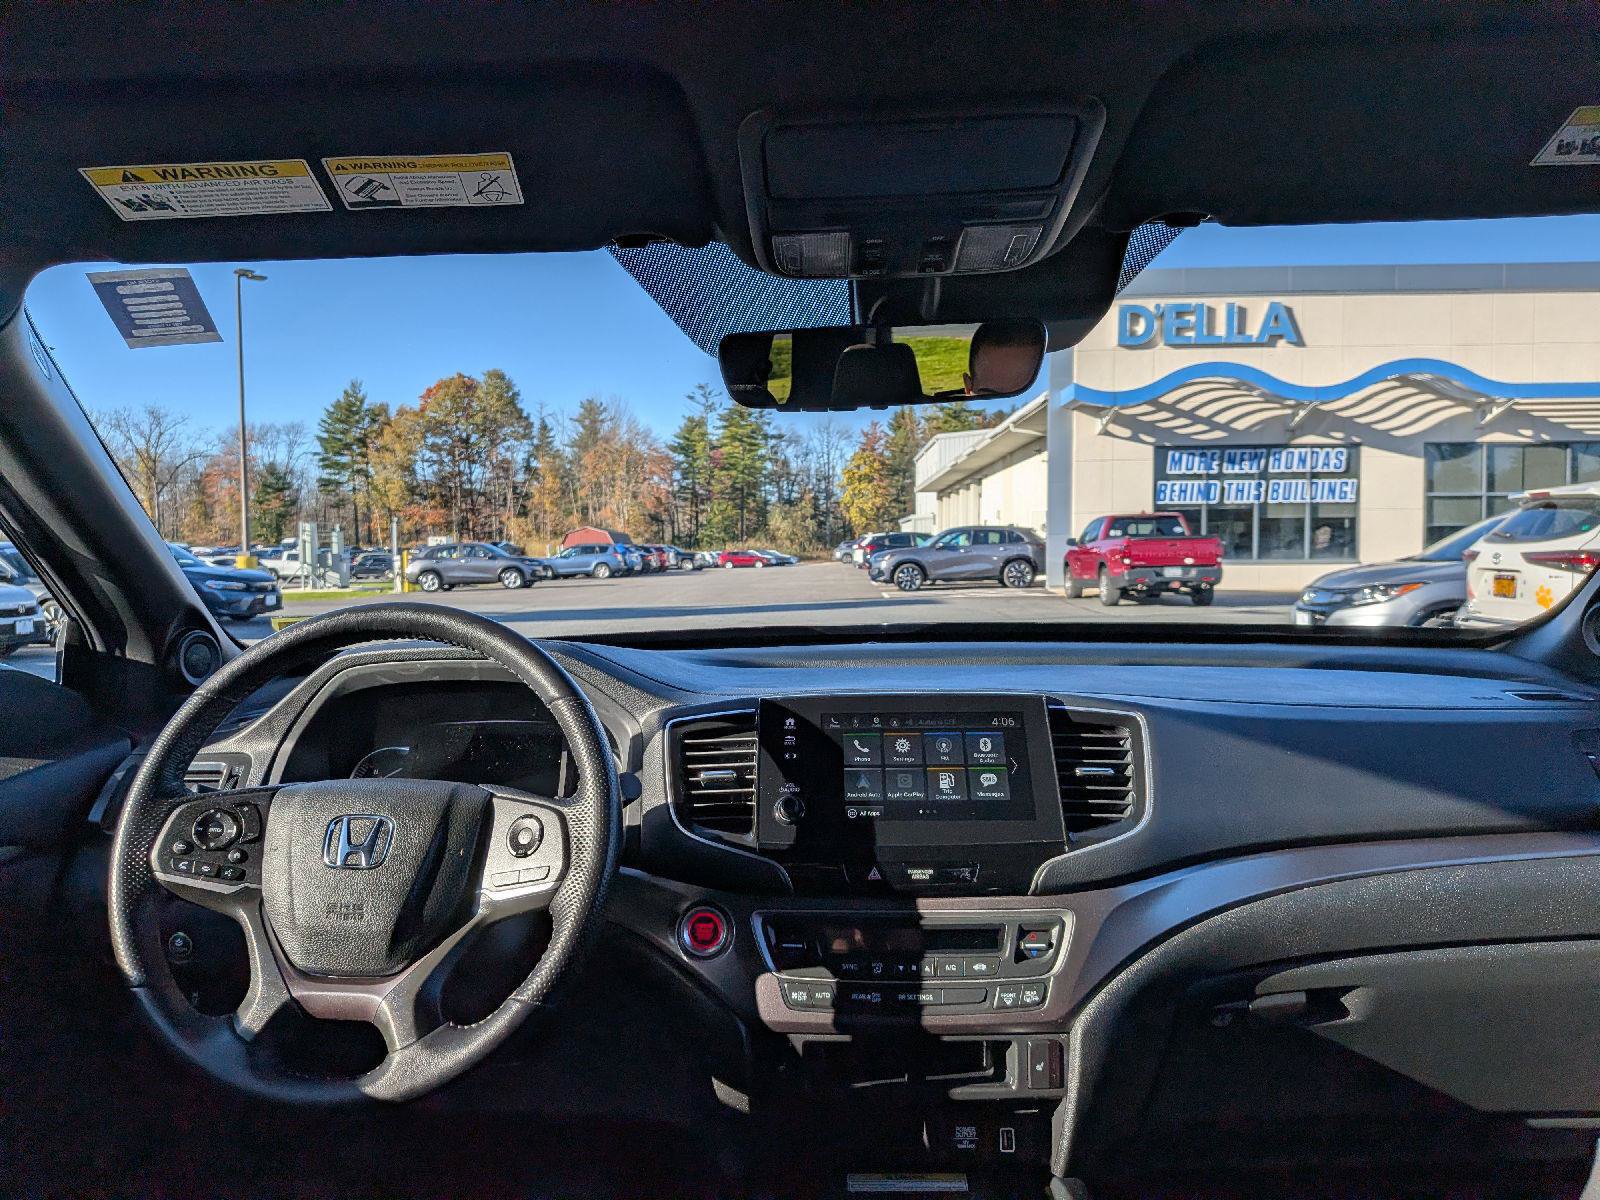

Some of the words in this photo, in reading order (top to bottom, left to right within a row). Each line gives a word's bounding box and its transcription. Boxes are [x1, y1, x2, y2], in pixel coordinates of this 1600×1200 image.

[119, 184, 151, 192] EVEN
[151, 183, 181, 191] WITH
[182, 180, 241, 189] ADVANCED
[243, 179, 263, 187] AIR
[263, 178, 294, 186] BAGS
[152, 164, 279, 181] WARNING
[1118, 301, 1299, 347] D'ELLA
[1166, 450, 1219, 474] MORE
[1223, 449, 1266, 473] NEW
[1268, 448, 1347, 473] HONDAS
[1157, 480, 1220, 504] BEHIND
[1223, 480, 1266, 503] THIS
[1267, 479, 1358, 503] BUILDING!
